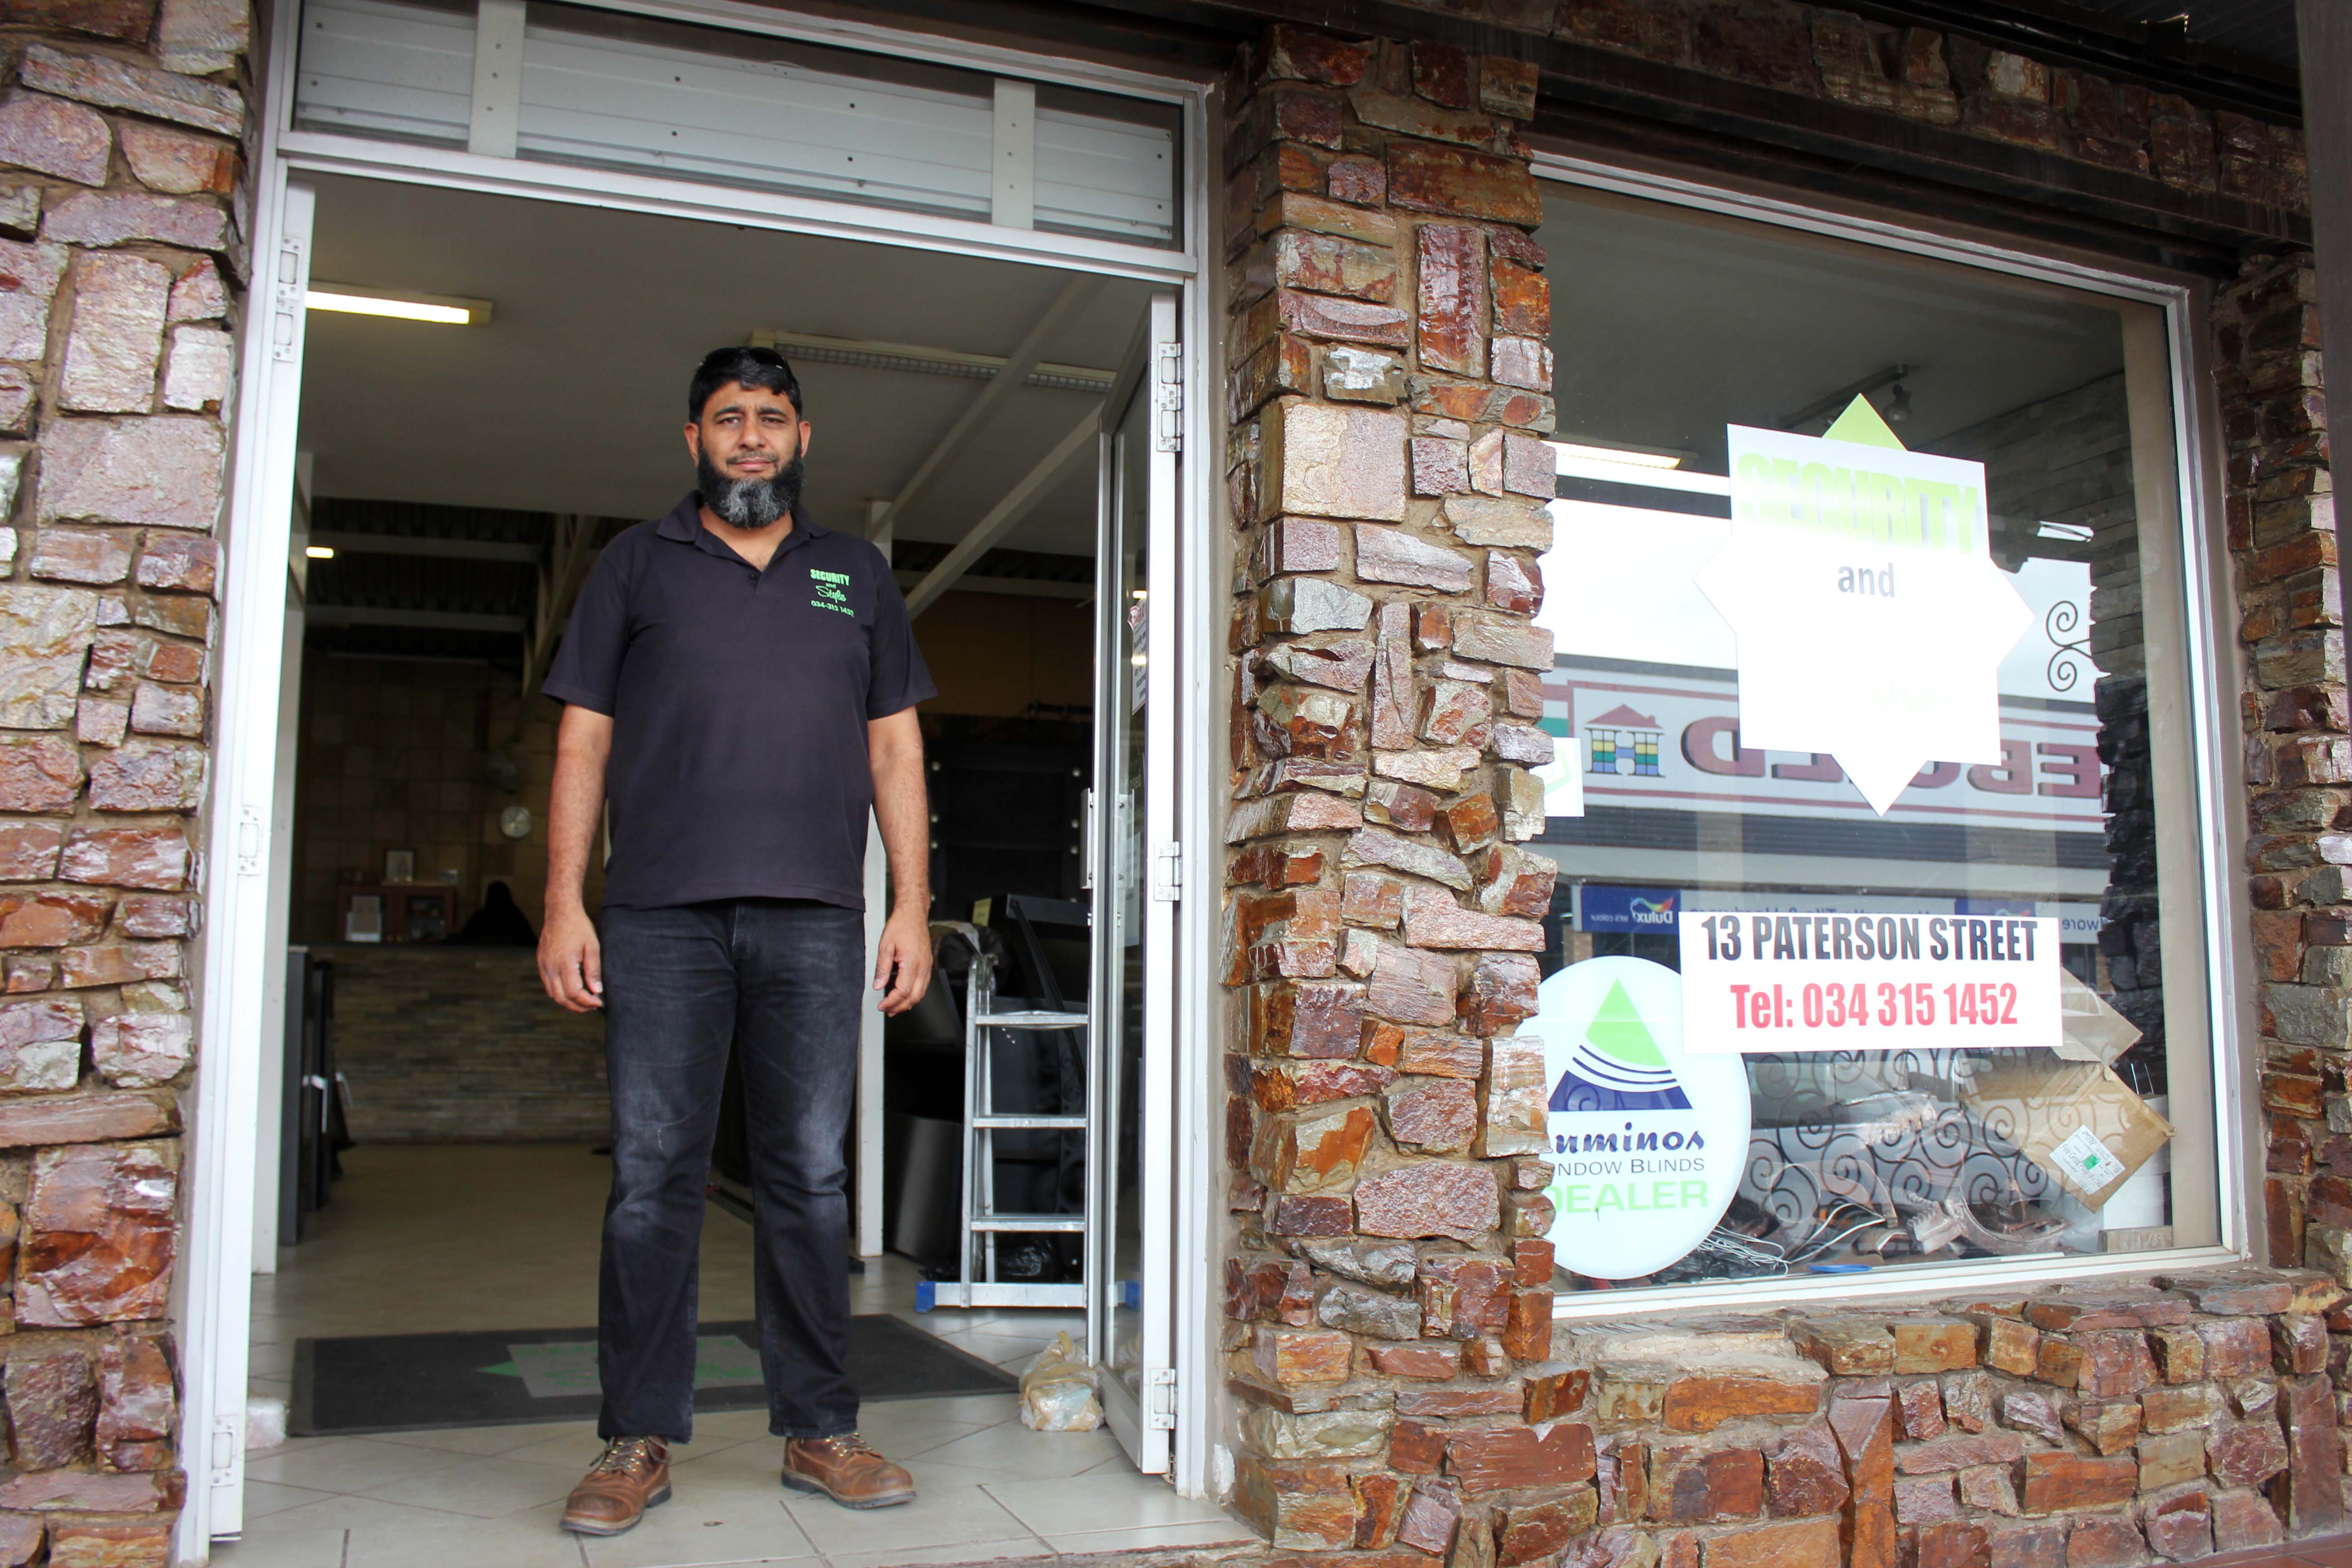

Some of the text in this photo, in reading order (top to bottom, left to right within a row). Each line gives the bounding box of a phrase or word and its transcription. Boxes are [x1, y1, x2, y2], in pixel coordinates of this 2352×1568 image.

[1737, 453, 1978, 555] SECURITY
[810, 568, 849, 586] SECURITY
[1838, 563, 1895, 598] and
[815, 585, 847, 603] Style
[840, 606, 854, 617] 1452
[1701, 916, 2038, 961] 13 PATERSON STREET
[1730, 982, 2018, 1029] Tel: 034 315 1452
[1555, 1121, 1705, 1154] uminos
[1558, 1157, 1705, 1177] NDOW BLINDS
